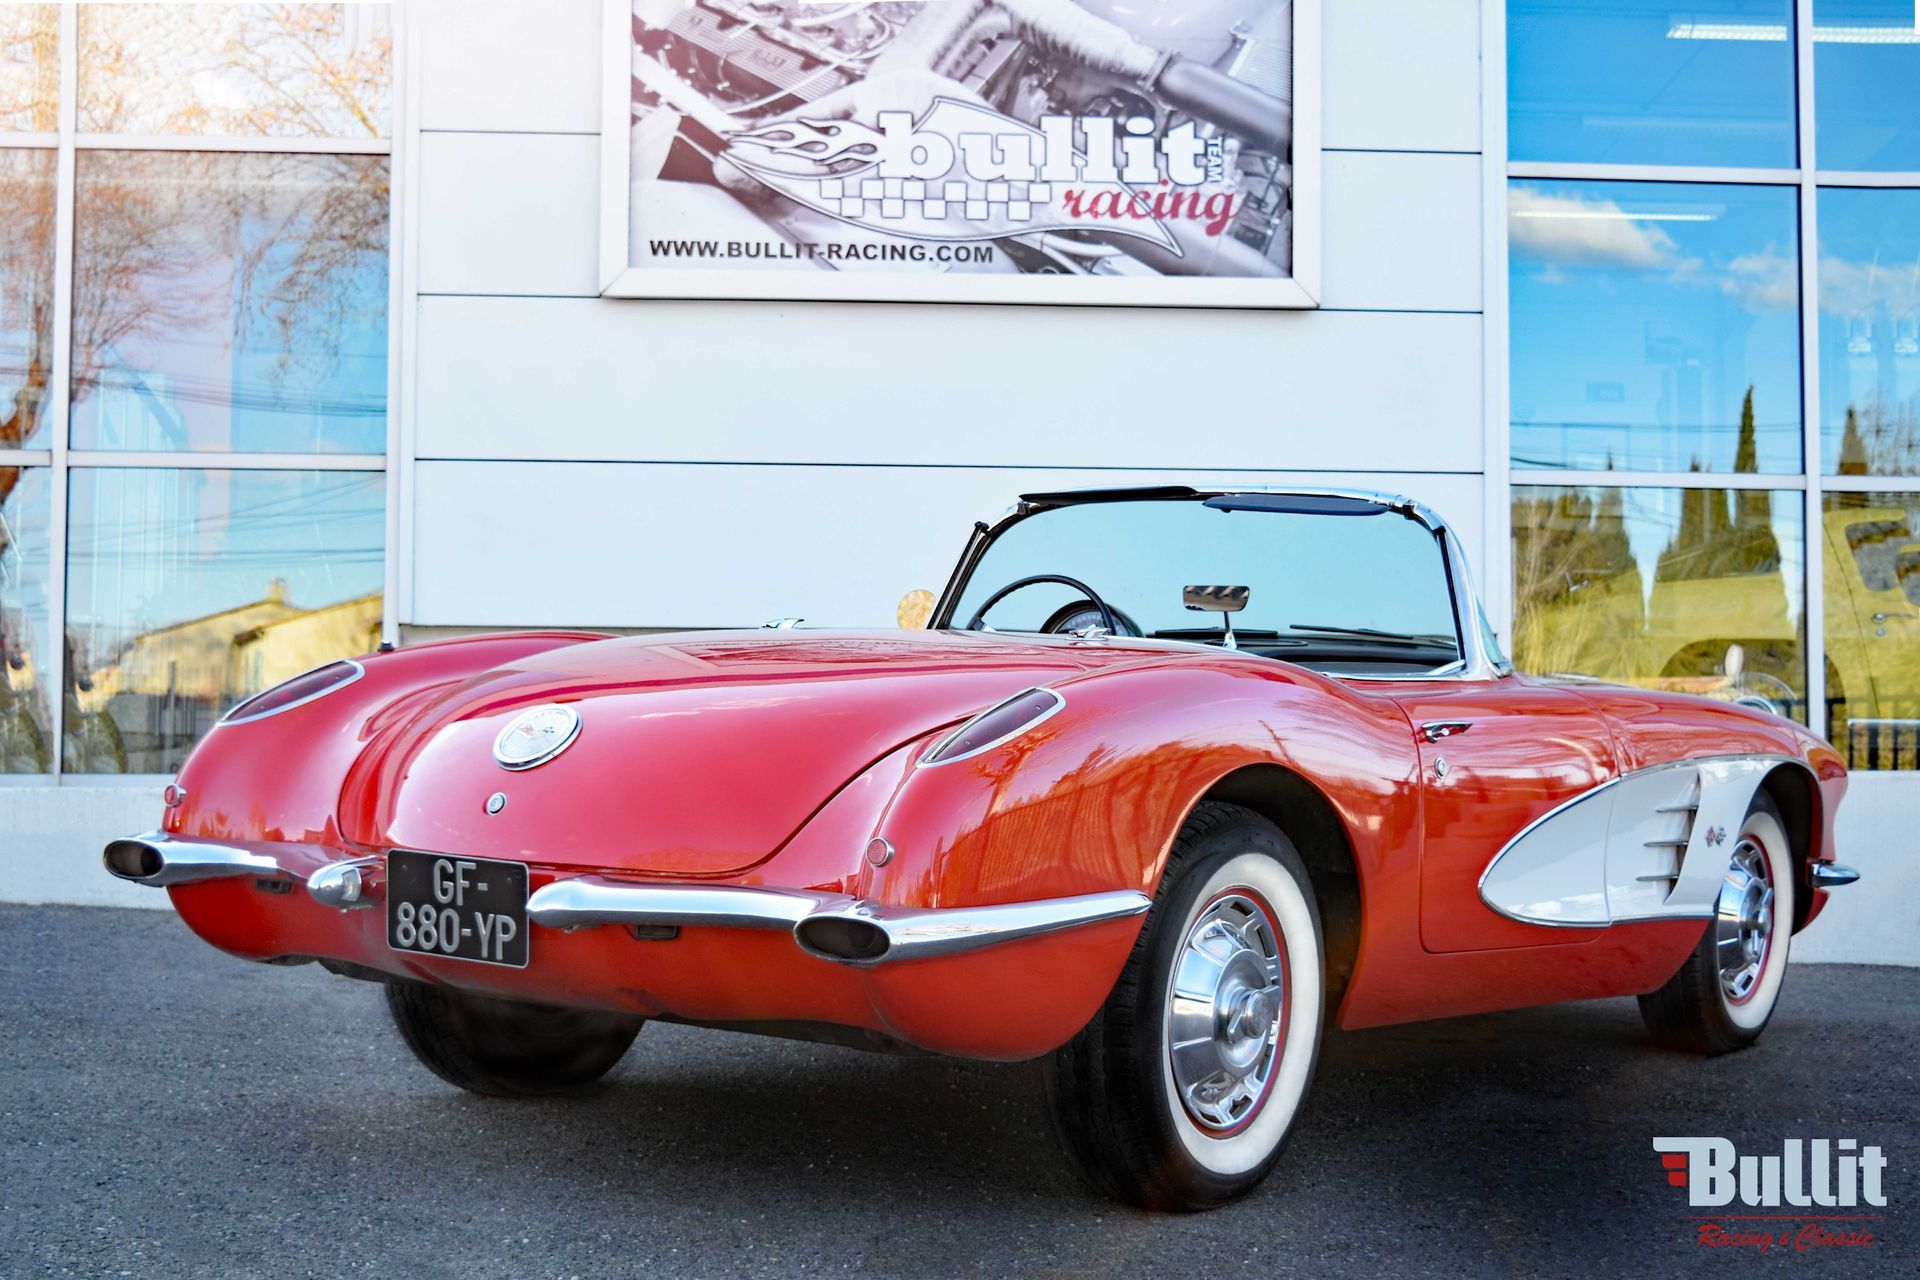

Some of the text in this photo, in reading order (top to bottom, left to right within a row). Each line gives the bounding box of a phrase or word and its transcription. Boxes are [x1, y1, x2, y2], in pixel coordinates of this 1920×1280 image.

[878, 111, 1208, 186] bullit
[1206, 136, 1223, 184] TEAM
[1063, 178, 1241, 237] racing
[649, 239, 994, 264] WWW.BULLIT-RACING.COM
[396, 901, 517, 961] 880-YP
